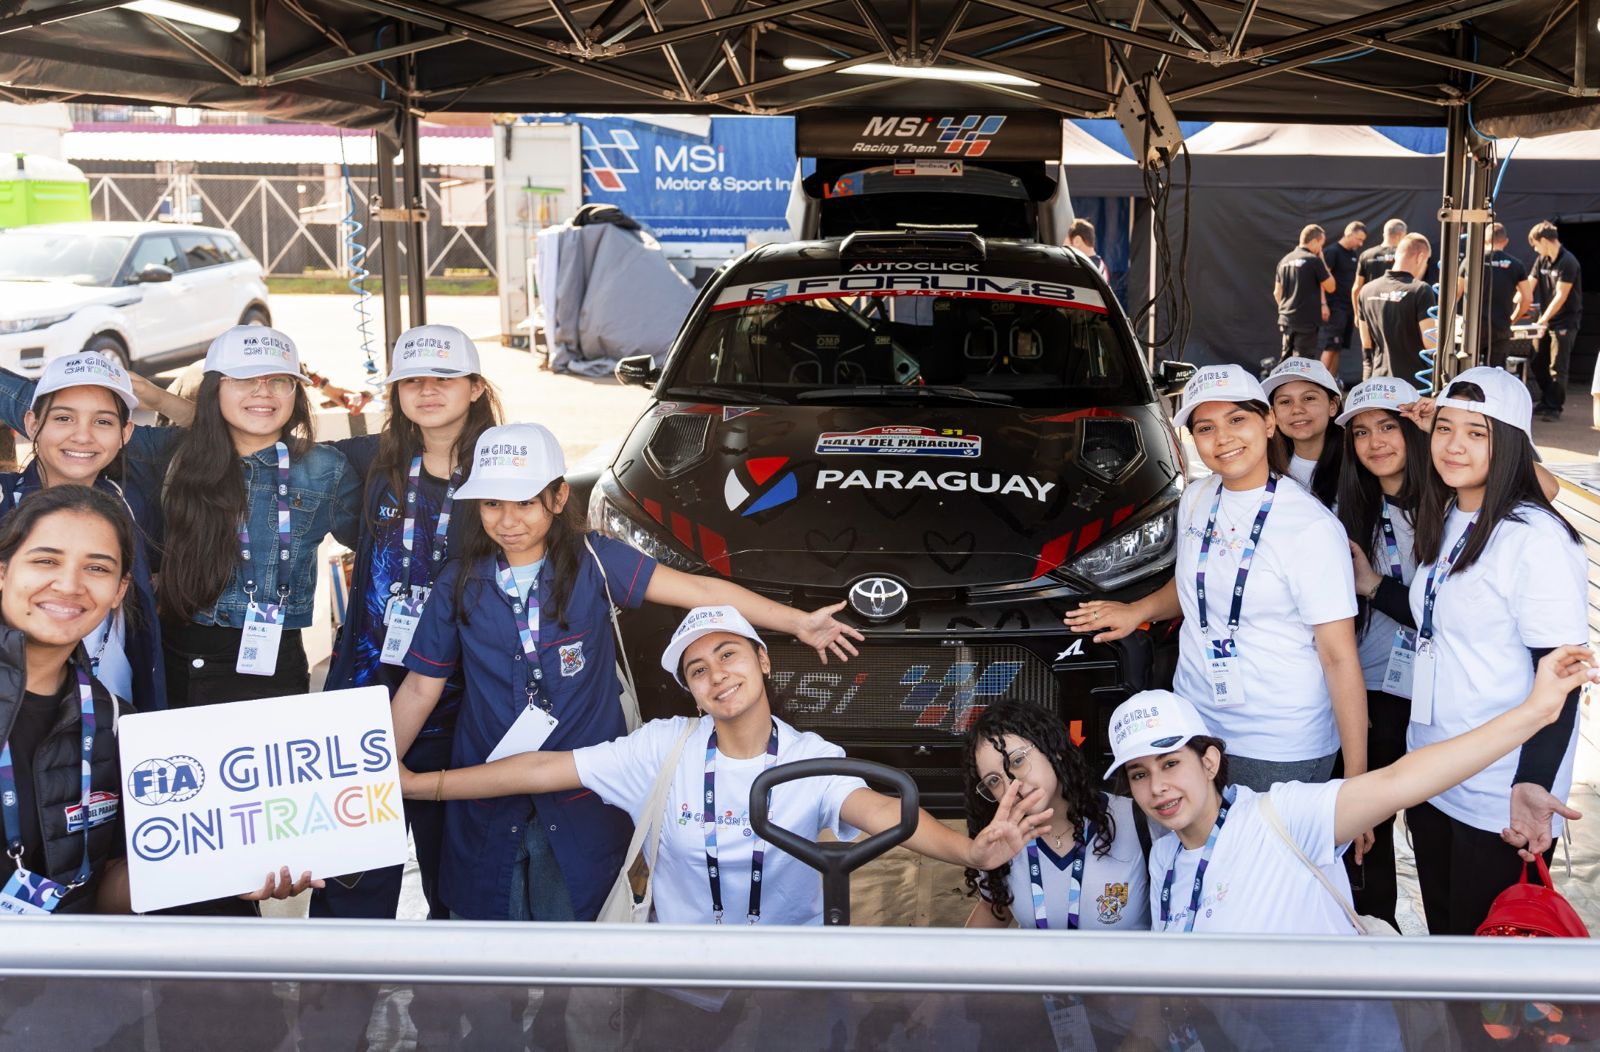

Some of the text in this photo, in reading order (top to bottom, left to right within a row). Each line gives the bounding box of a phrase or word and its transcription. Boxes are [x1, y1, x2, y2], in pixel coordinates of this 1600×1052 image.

[852, 142, 937, 155] Racing Team
[656, 177, 706, 191] Motor
[723, 176, 771, 193] Sport
[776, 177, 793, 191] In
[849, 262, 980, 273] AUTOCLICK
[798, 274, 1076, 300] FORUM8
[261, 337, 291, 353] GIRLS
[416, 337, 451, 350] GIRLS
[85, 357, 121, 377] GIRLS
[1198, 371, 1229, 384] GIRLS
[1365, 383, 1396, 393] GIRLS
[941, 428, 963, 436] 31
[868, 438, 894, 447] DEL
[898, 439, 976, 448] PARAGUAY
[492, 444, 528, 456] GIRLS
[815, 469, 1056, 502] PARAGUAY
[688, 610, 724, 625] GIRLS
[1123, 706, 1159, 725] GIRLS
[219, 729, 391, 792] GIRLS
[69, 813, 84, 822] RALL
